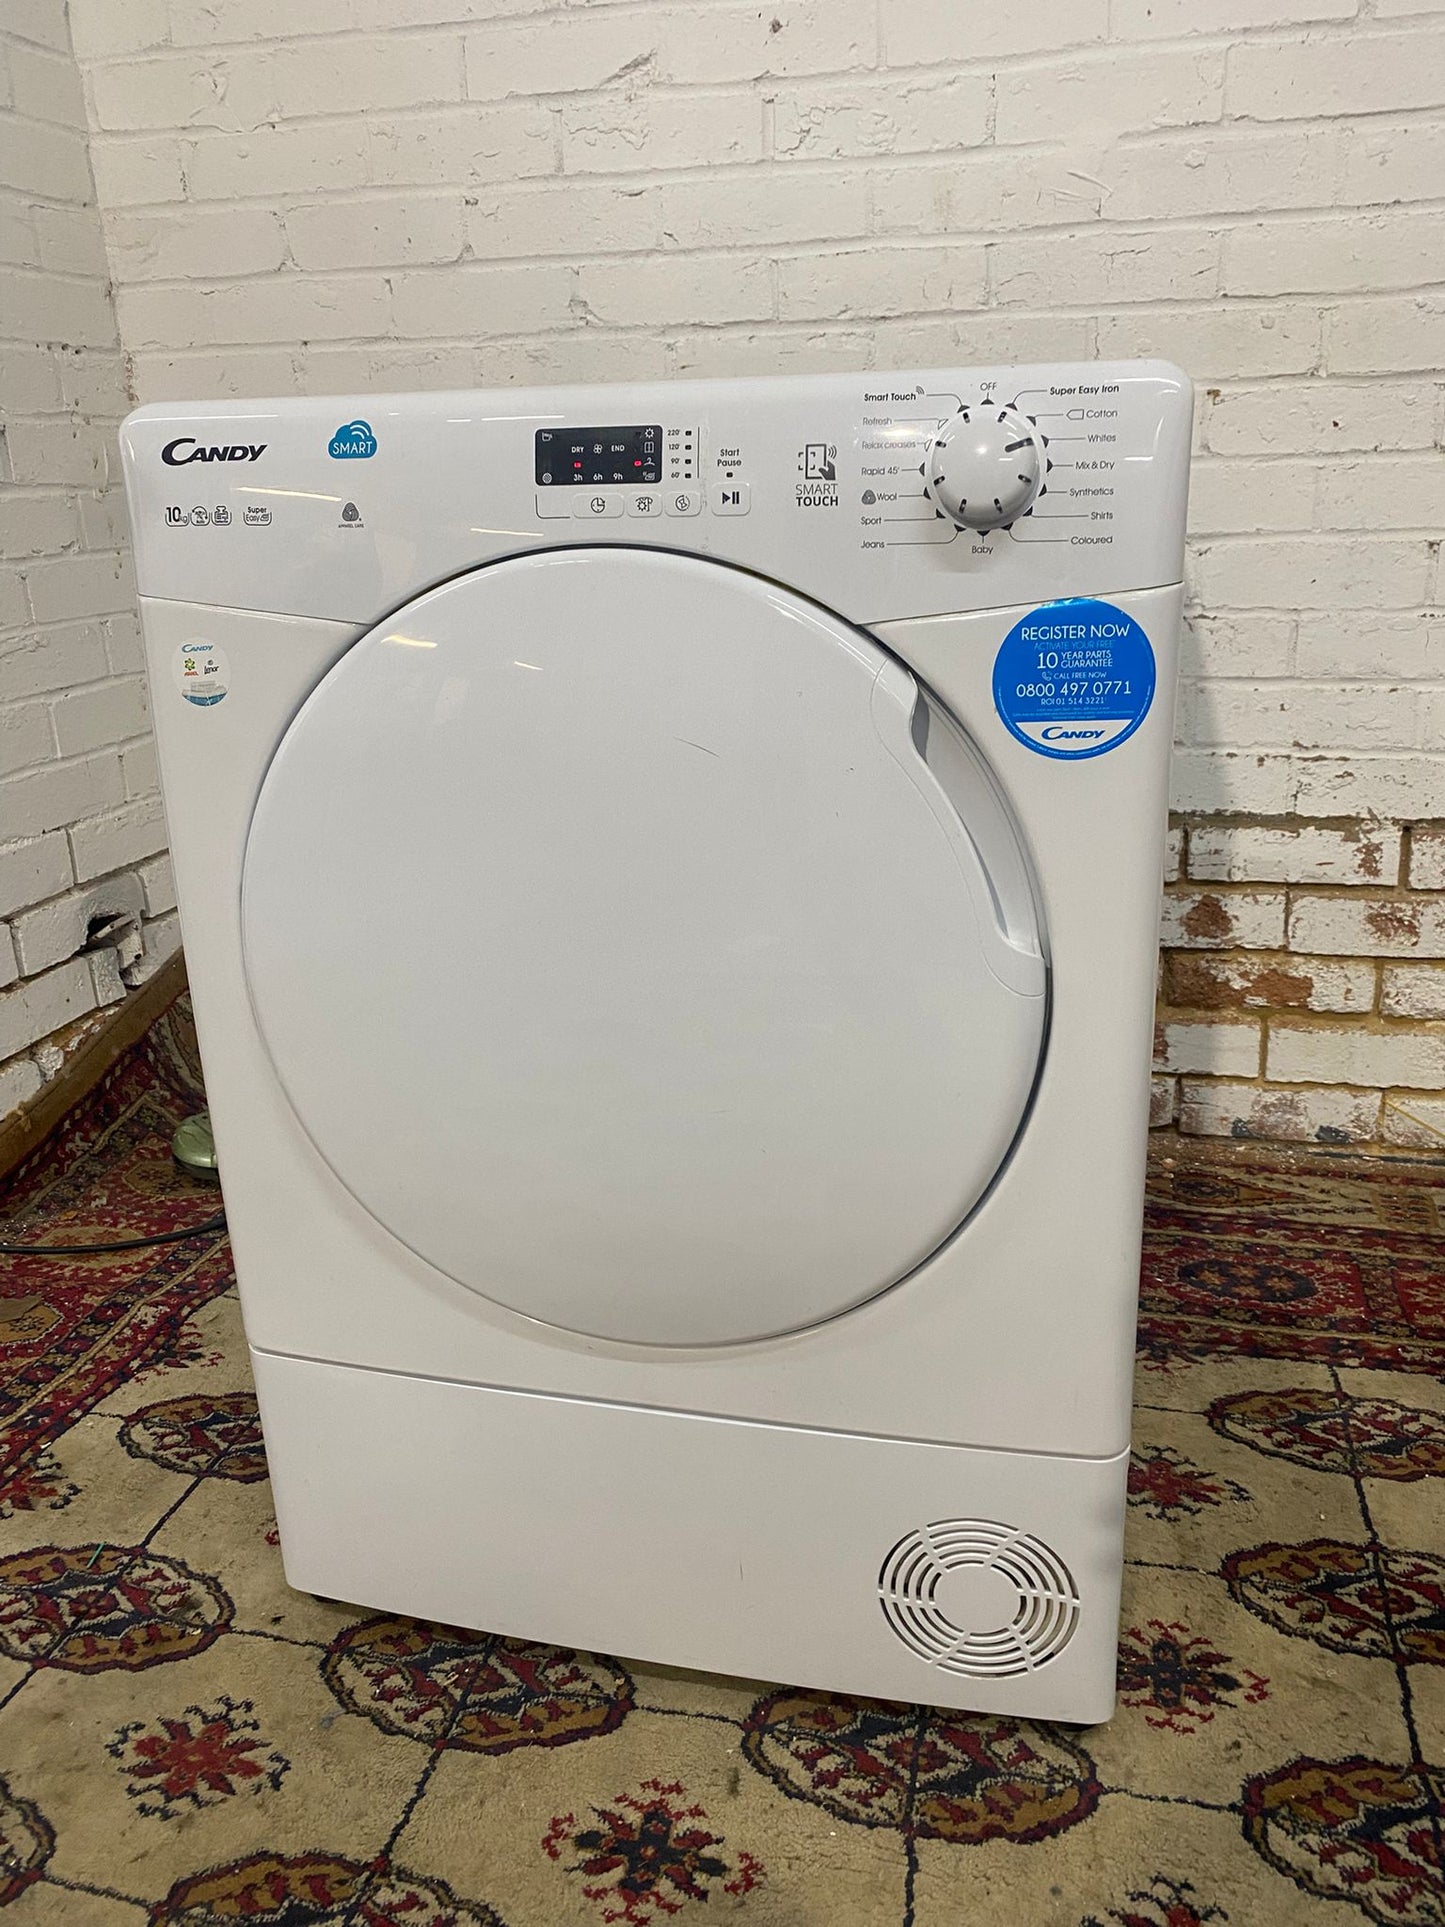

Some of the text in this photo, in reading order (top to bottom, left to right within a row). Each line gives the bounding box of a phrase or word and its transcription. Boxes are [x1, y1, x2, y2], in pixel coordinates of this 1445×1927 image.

[980, 382, 997, 391] OFF
[1049, 384, 1120, 396] Super Easy Iron
[891, 393, 916, 401] Touch
[1086, 409, 1118, 418] Cotton
[863, 417, 893, 426] Refresh
[1088, 434, 1116, 442] Whites
[161, 438, 268, 466] CANDY
[333, 442, 372, 455] SMART
[611, 444, 625, 452] END
[720, 448, 740, 457] Start
[717, 459, 742, 467] Pause
[1075, 460, 1089, 469] Mix
[1100, 460, 1115, 470] Dry
[861, 467, 885, 477] Rapid
[796, 484, 838, 495] SMART
[1069, 487, 1114, 498] Synthetics
[796, 496, 838, 507] TOUCH
[877, 493, 897, 501] Wool
[861, 516, 882, 526] Sport
[1090, 512, 1113, 520] Shirts
[861, 540, 885, 549] Jeans
[1070, 536, 1113, 545] Coloured
[971, 546, 994, 555] Baby
[1021, 623, 1130, 640] REGISTER NOW
[181, 643, 214, 653] CANDY
[1061, 650, 1112, 660] YEAR PARTS
[1037, 652, 1058, 669] 10
[1061, 658, 1113, 669] GUARANTEE
[1088, 671, 1107, 679] NOW
[1016, 680, 1132, 697] 0800 497 0771
[1085, 697, 1104, 705] 3221
[1041, 726, 1106, 740] CANDY
